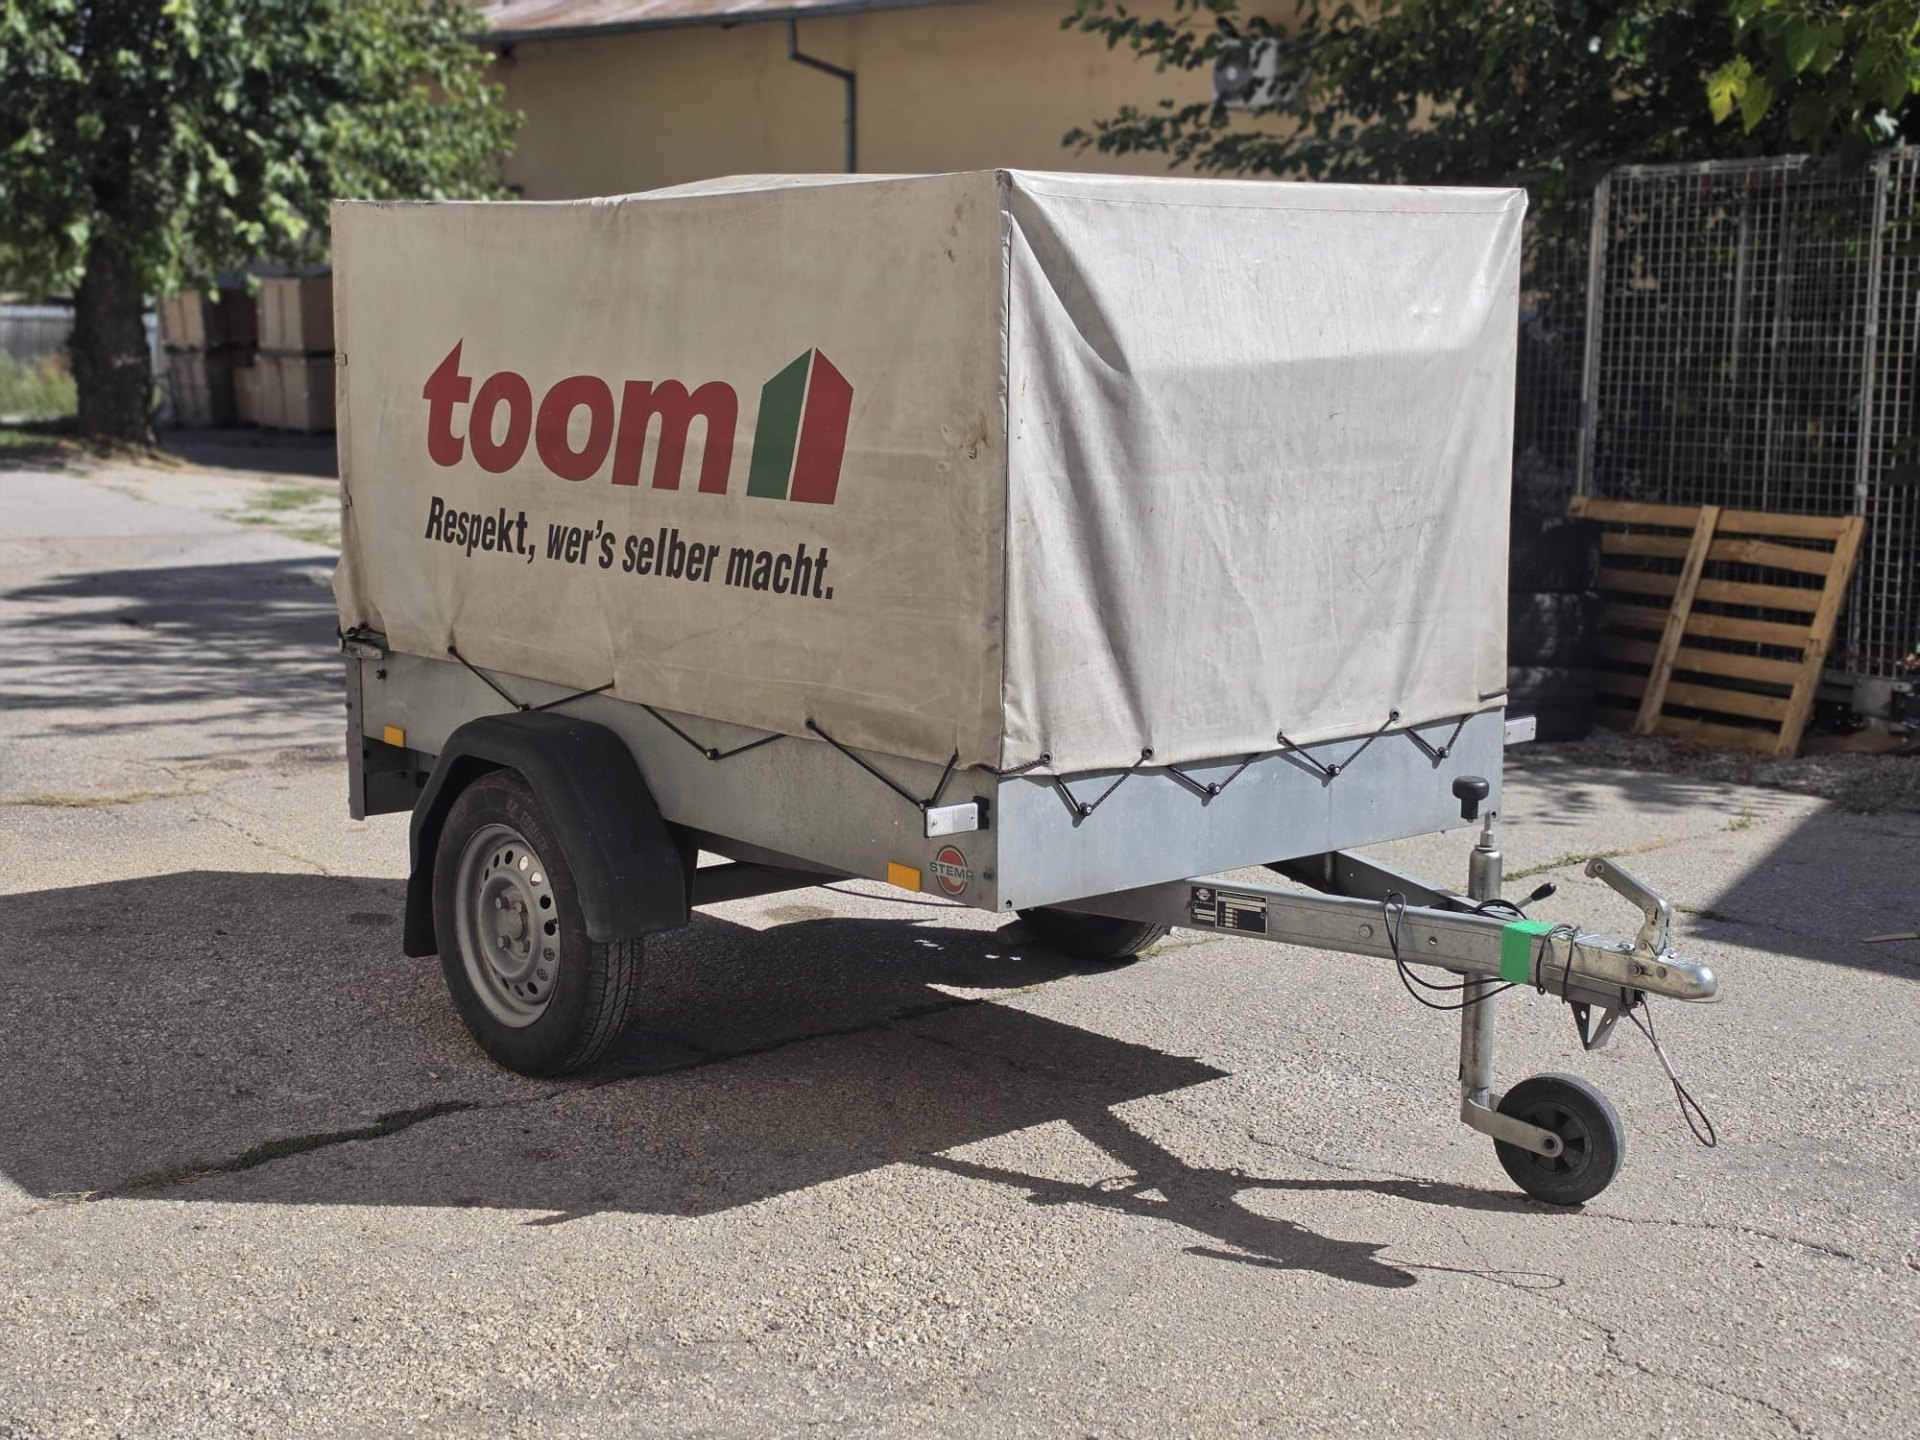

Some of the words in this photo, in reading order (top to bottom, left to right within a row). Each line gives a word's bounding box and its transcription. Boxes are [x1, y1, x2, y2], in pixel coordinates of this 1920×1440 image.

[423, 337, 739, 495] toom
[424, 496, 536, 565] Respekt,
[546, 520, 615, 570] wer's
[622, 528, 720, 583] selber
[724, 543, 834, 600] macht.
